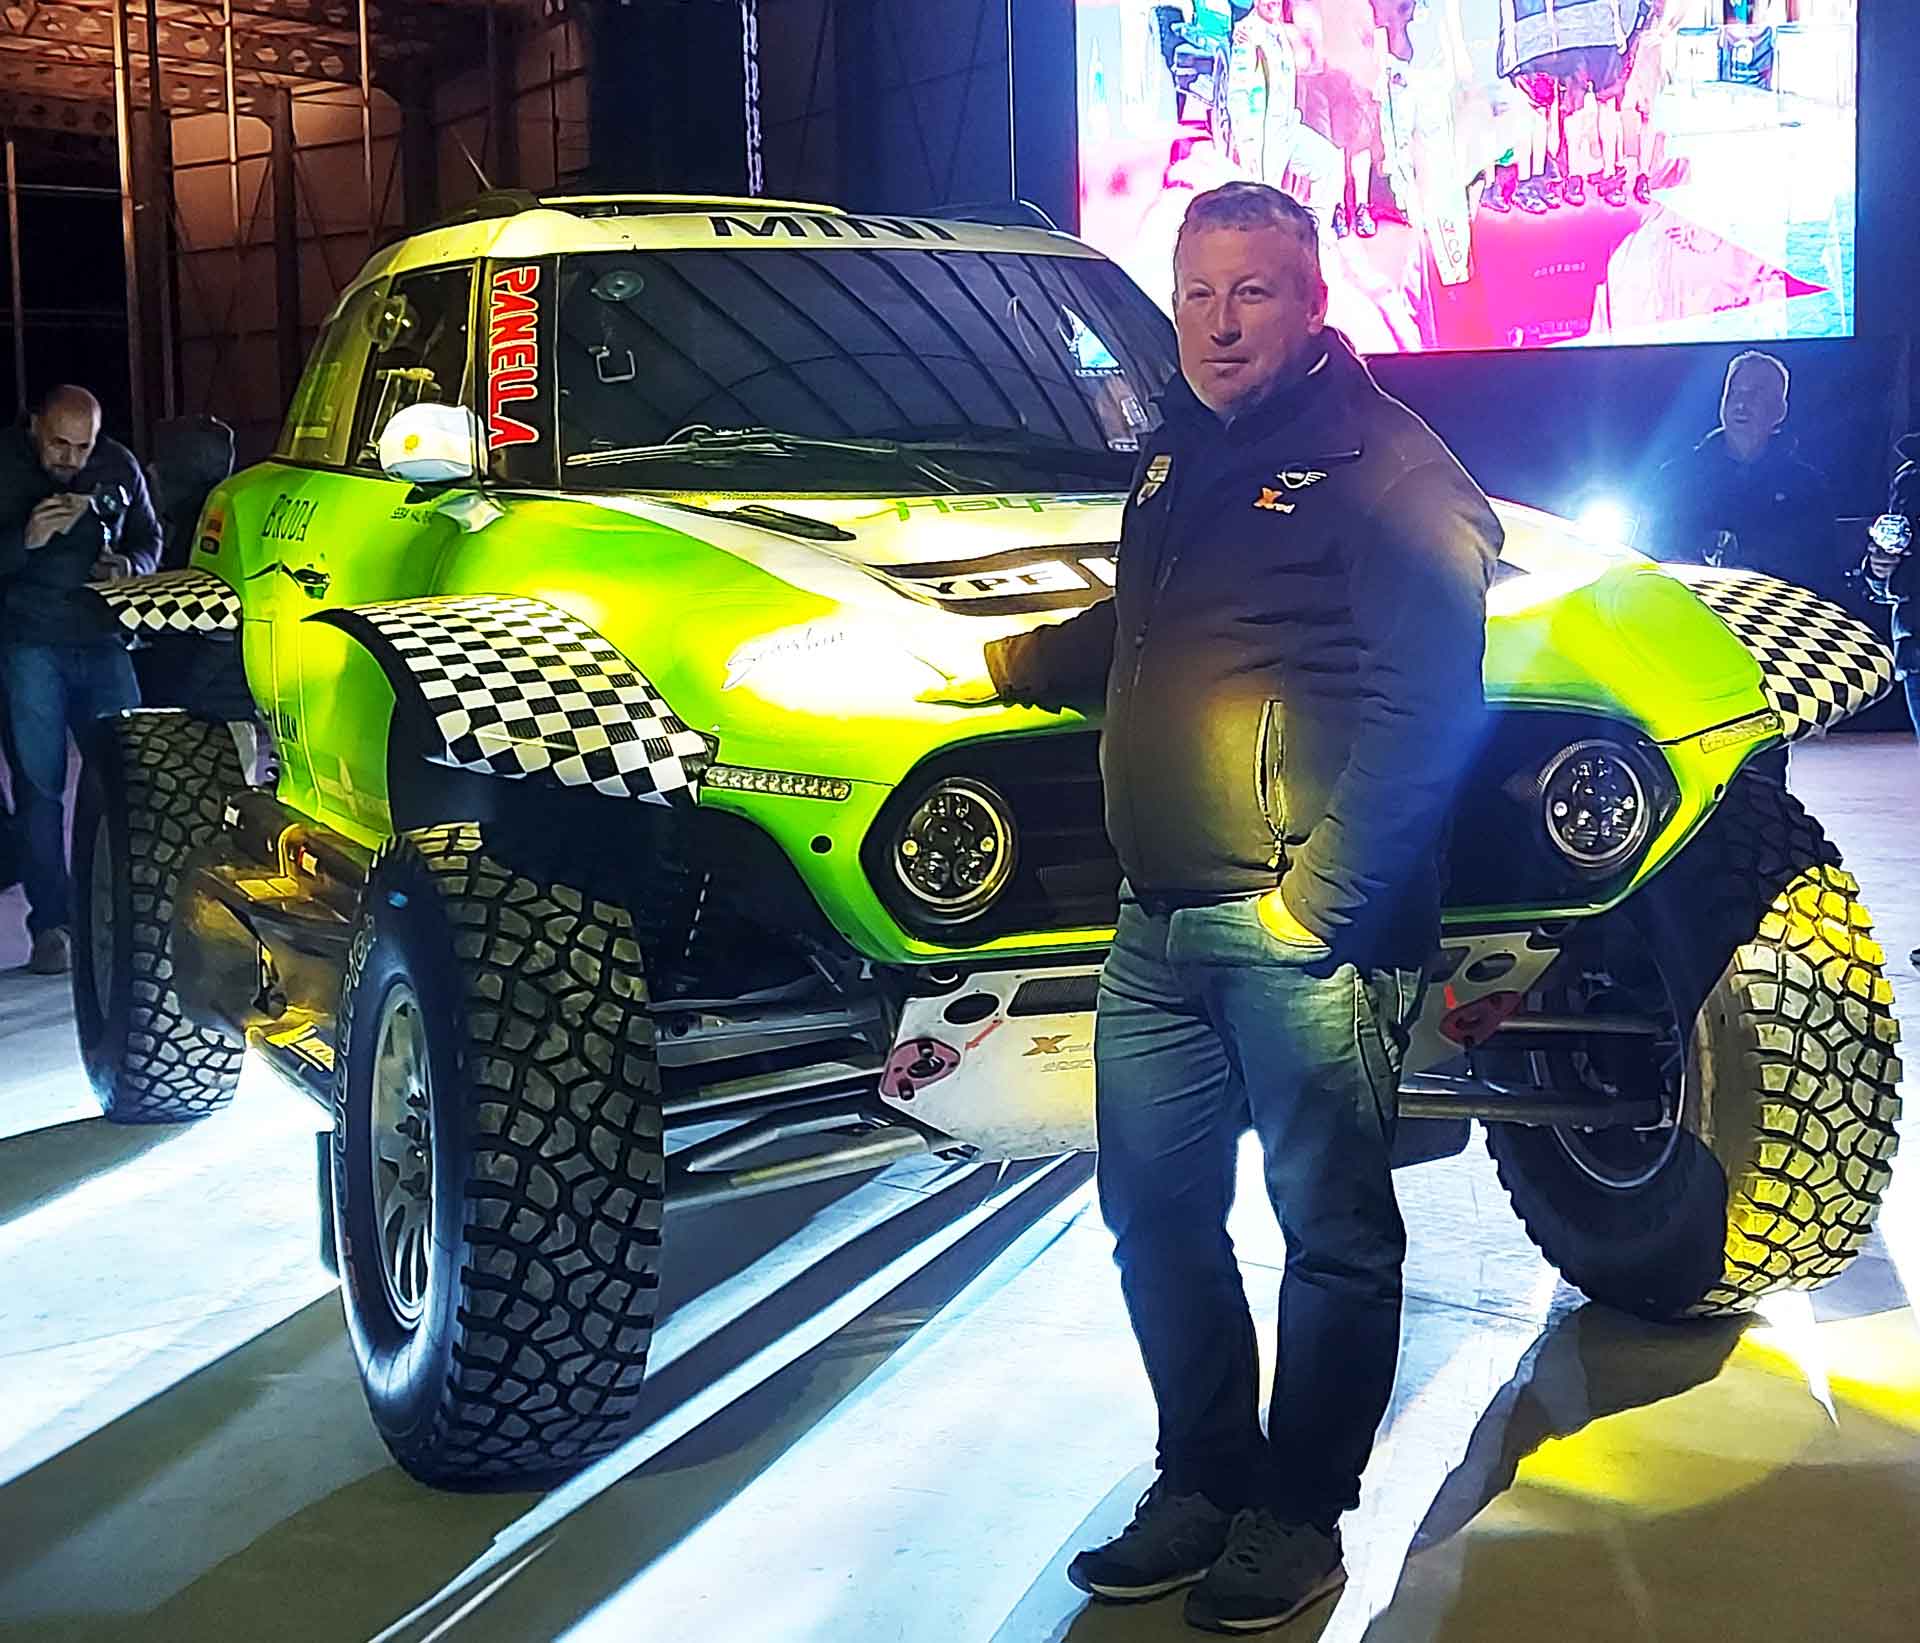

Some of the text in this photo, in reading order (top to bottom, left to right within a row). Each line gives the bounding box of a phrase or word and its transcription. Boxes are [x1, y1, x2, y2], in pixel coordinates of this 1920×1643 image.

[708, 215, 958, 241] MINI
[488, 265, 541, 452] PANELLA
[912, 569, 1054, 596] YPF
